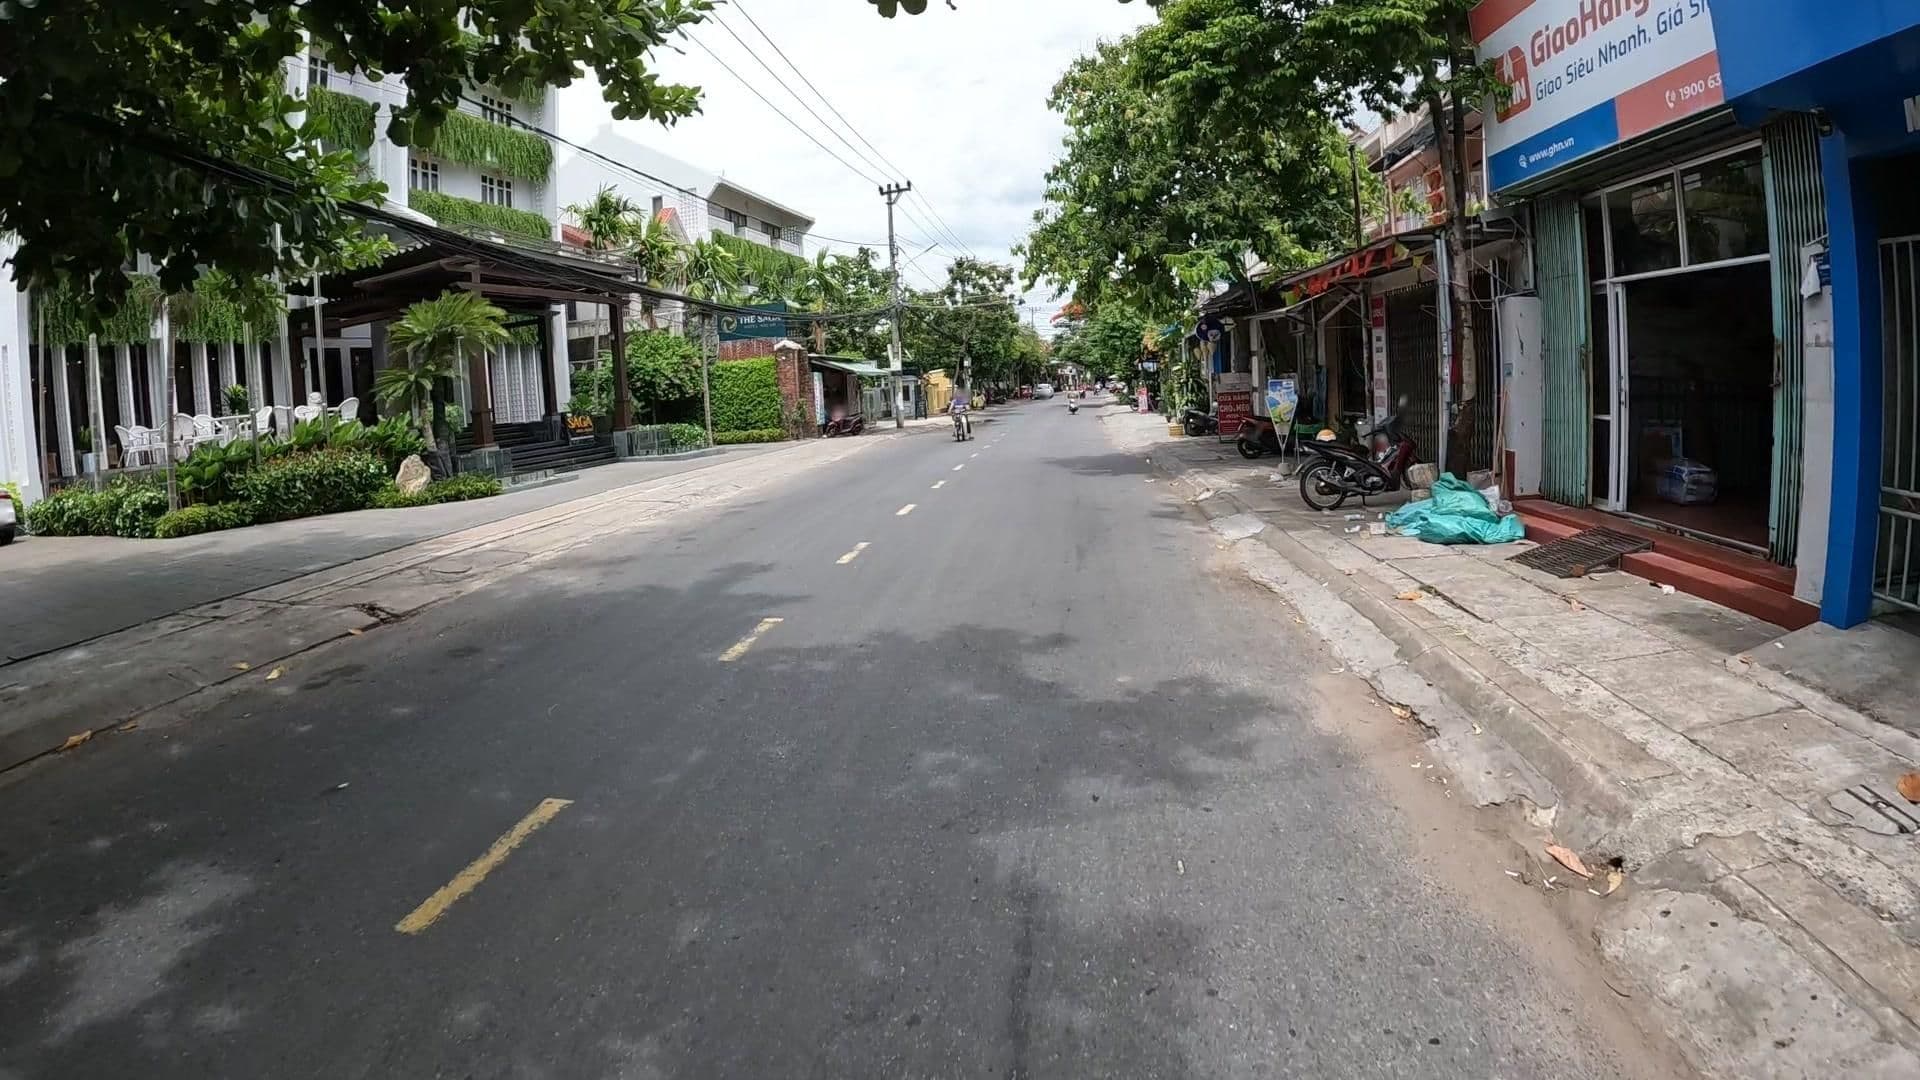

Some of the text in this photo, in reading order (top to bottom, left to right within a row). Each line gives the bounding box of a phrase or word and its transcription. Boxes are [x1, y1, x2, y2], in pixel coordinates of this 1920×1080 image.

[1535, 76, 1562, 101] Giao
[1566, 54, 1594, 85] Siêu
[1599, 24, 1652, 68] Nhanh,
[1656, 2, 1684, 36] Giá
[1679, 79, 1705, 101] 1900
[1528, 136, 1575, 164] www.ghn.vn
[738, 315, 756, 324] THE
